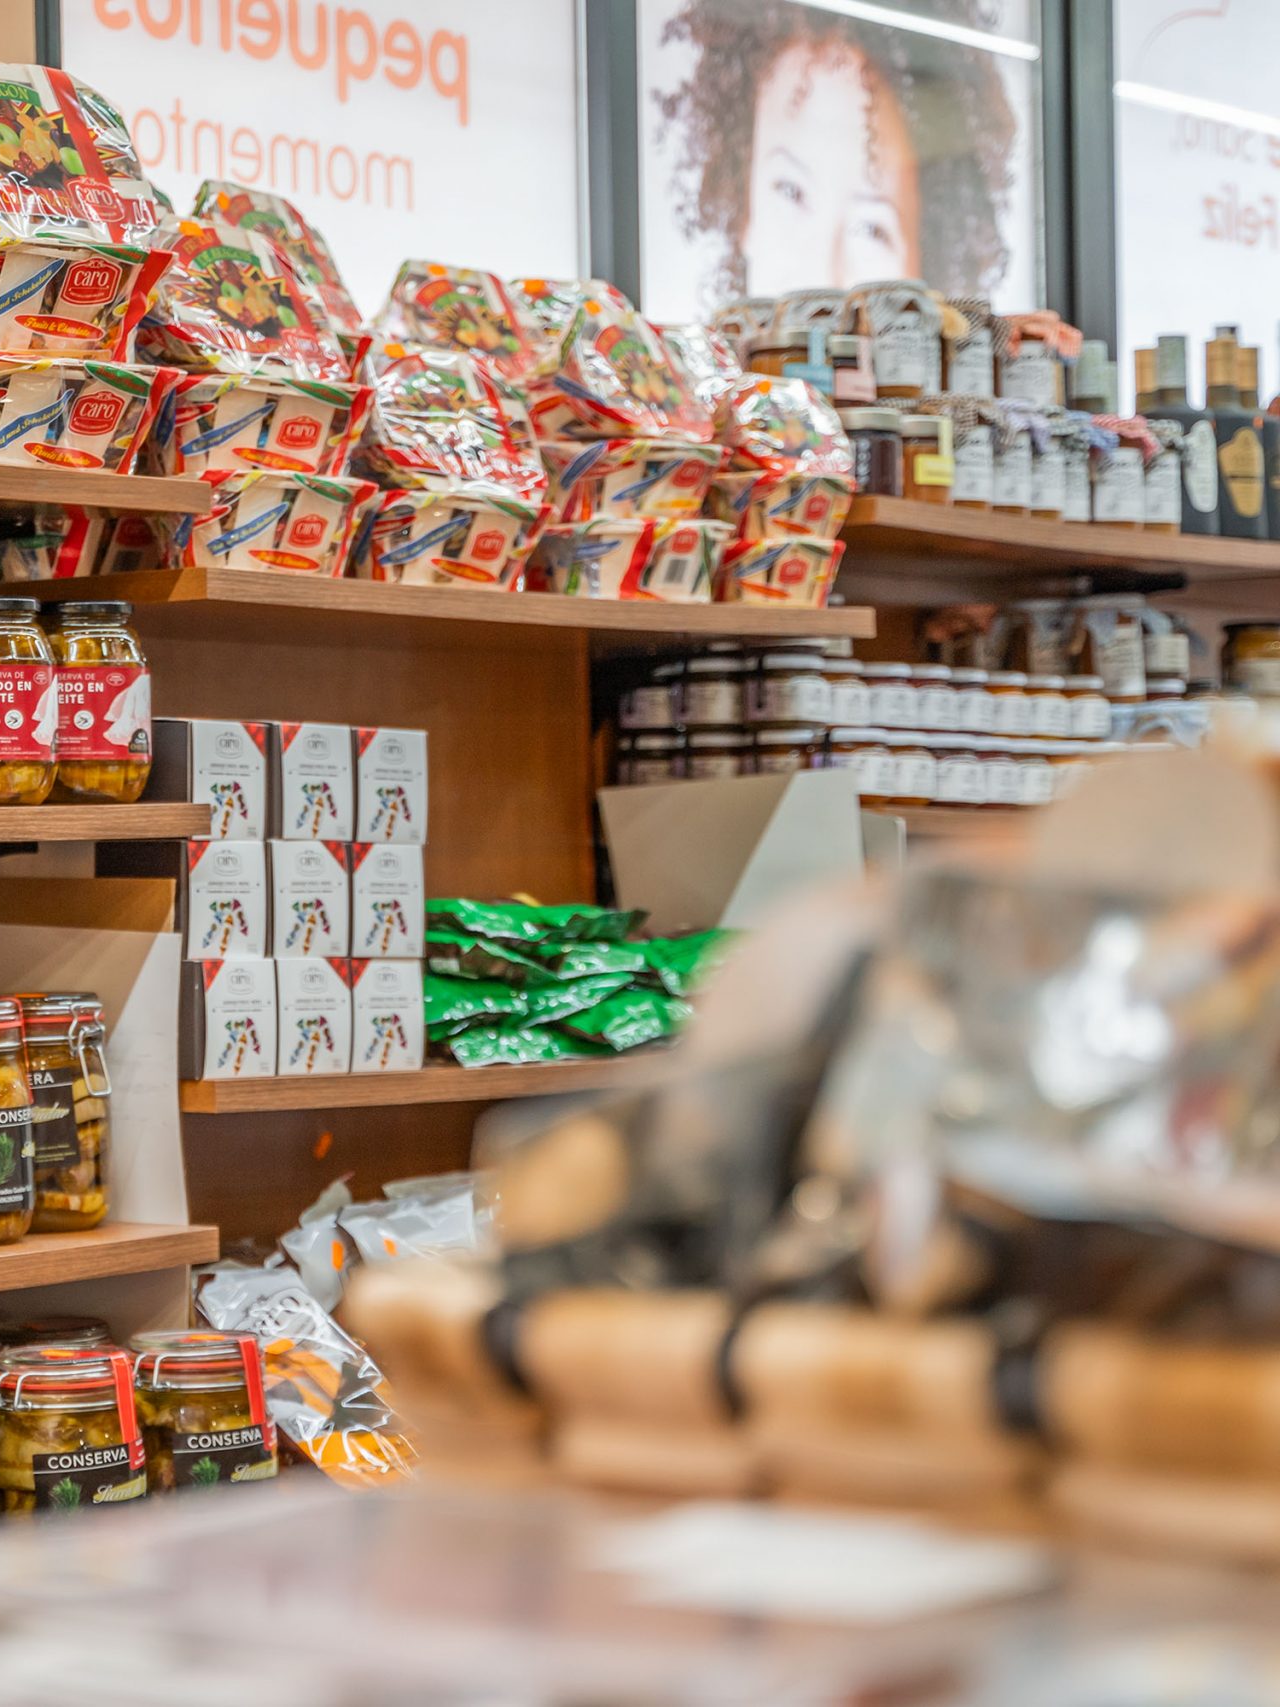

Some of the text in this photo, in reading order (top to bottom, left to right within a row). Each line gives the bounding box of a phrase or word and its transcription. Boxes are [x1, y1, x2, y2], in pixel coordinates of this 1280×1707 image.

[74, 269, 109, 287] caro
[79, 401, 113, 418] caro
[15, 671, 24, 680] DE
[58, 673, 95, 681] SERVA DE
[18, 681, 31, 692] EN
[58, 682, 104, 693] RDO EN
[58, 694, 84, 704] EITE
[187, 1430, 262, 1449] CONSERVA
[47, 1448, 128, 1470] CONSERVA
